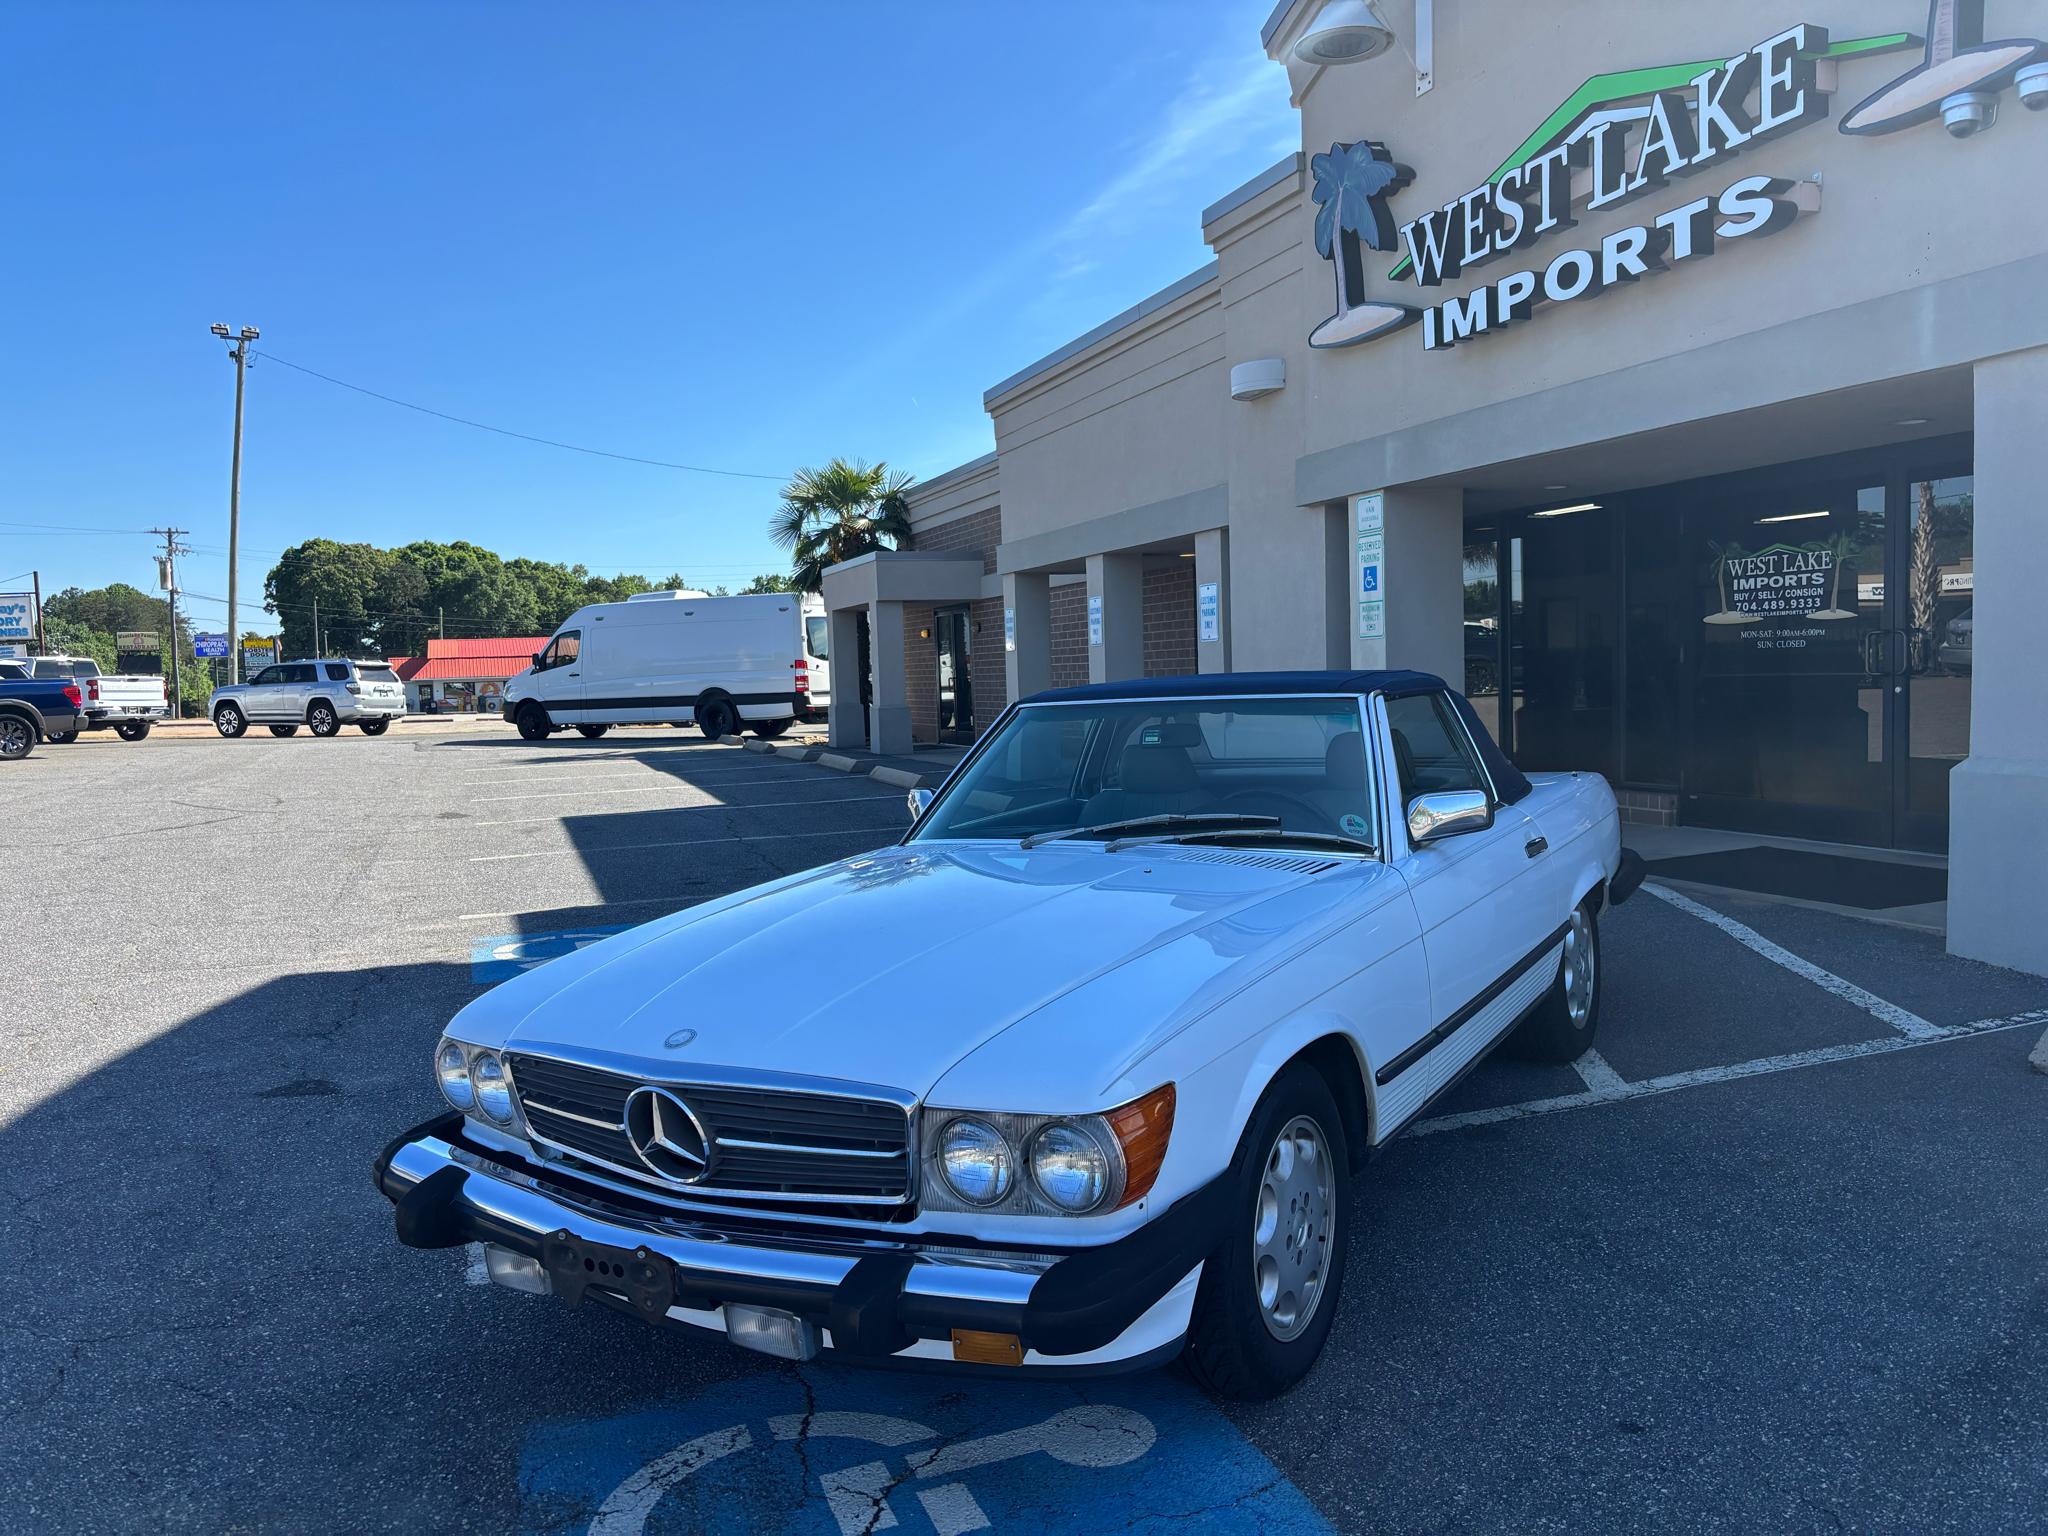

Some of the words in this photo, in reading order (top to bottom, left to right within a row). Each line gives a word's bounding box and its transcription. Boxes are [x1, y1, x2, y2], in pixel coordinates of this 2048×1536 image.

[1400, 144, 1568, 285] WEST
[1586, 23, 1806, 211] LAKE
[1423, 175, 1775, 350] IMPORTS
[1728, 556, 1777, 576] WEST
[1782, 550, 1832, 572] LAKE
[1733, 572, 1825, 591] IMPORTS
[1734, 590, 1749, 601] BUY
[1757, 591, 1777, 600] SELL
[1785, 587, 1824, 598] CONSIGN
[1736, 598, 1821, 612] 704.489.9333
[1740, 631, 1774, 639] MON-SAT:
[1776, 629, 1825, 638] 9:00AM-6:00PM
[1757, 641, 1774, 649] SUN:
[1776, 640, 1806, 648] CLOSED
